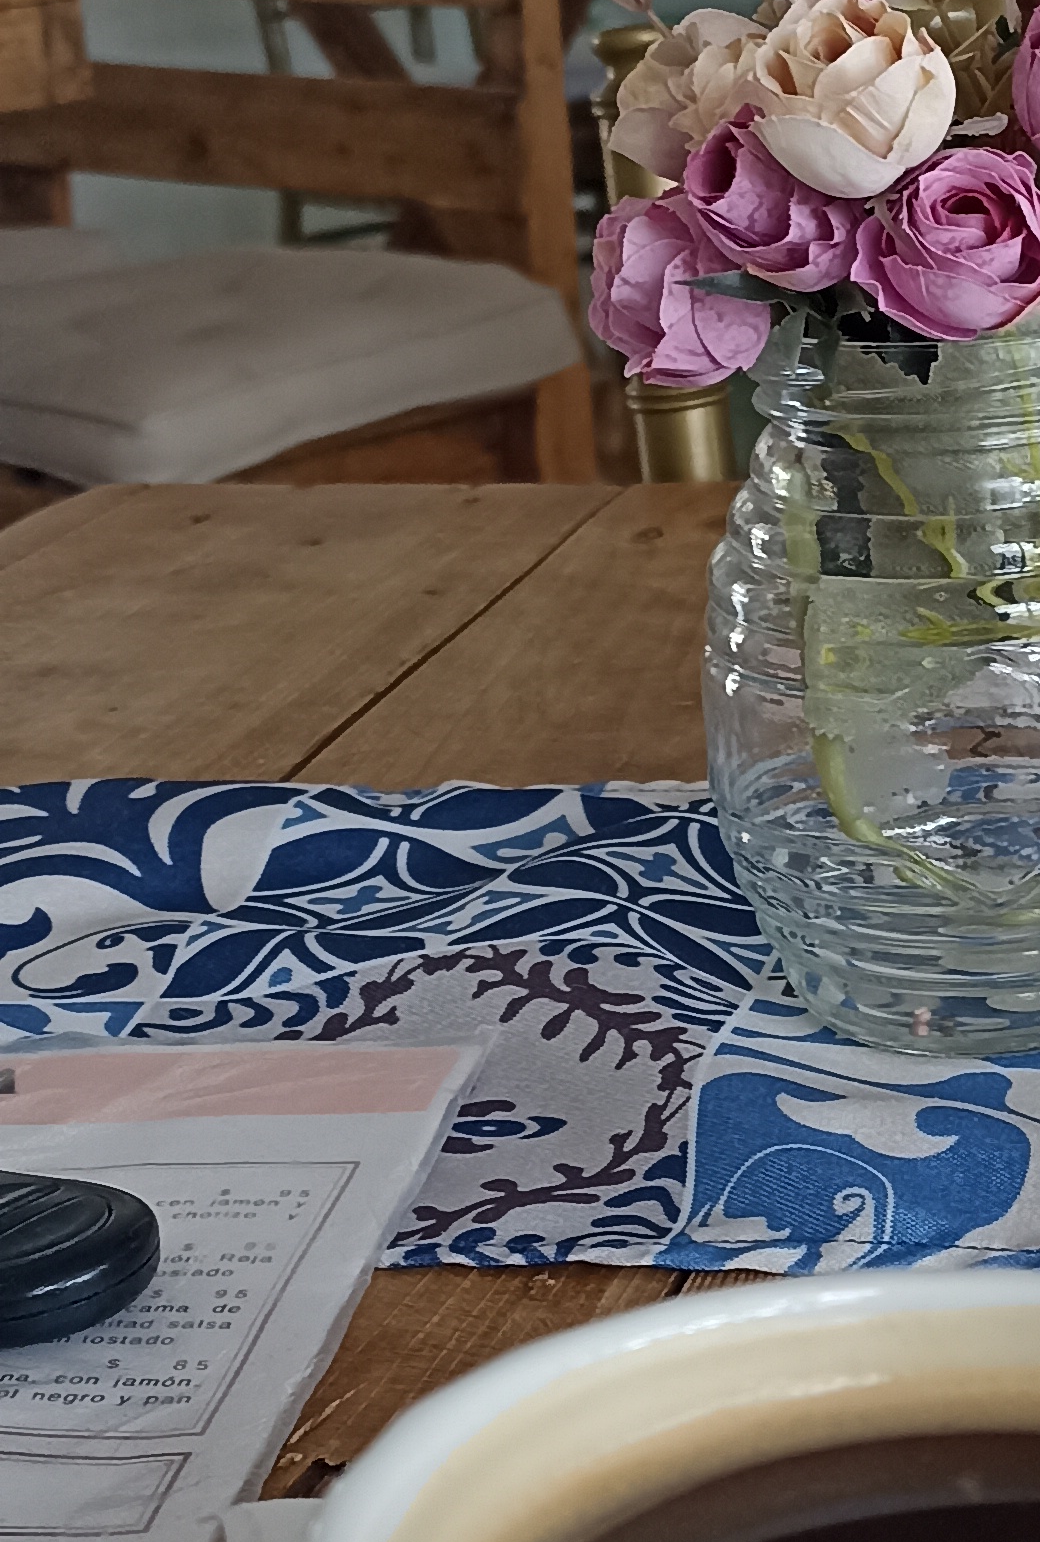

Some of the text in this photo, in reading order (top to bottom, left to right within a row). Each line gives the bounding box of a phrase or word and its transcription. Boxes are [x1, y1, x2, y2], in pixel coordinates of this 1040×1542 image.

[212, 1303, 243, 1314] de
[167, 1319, 232, 1330] salsa
[82, 1334, 175, 1346] tostado
[172, 1359, 210, 1371] 85
[54, 1374, 100, 1386] con
[32, 1390, 106, 1406] negro
[116, 1394, 132, 1407] y
[142, 1394, 193, 1407] pan
